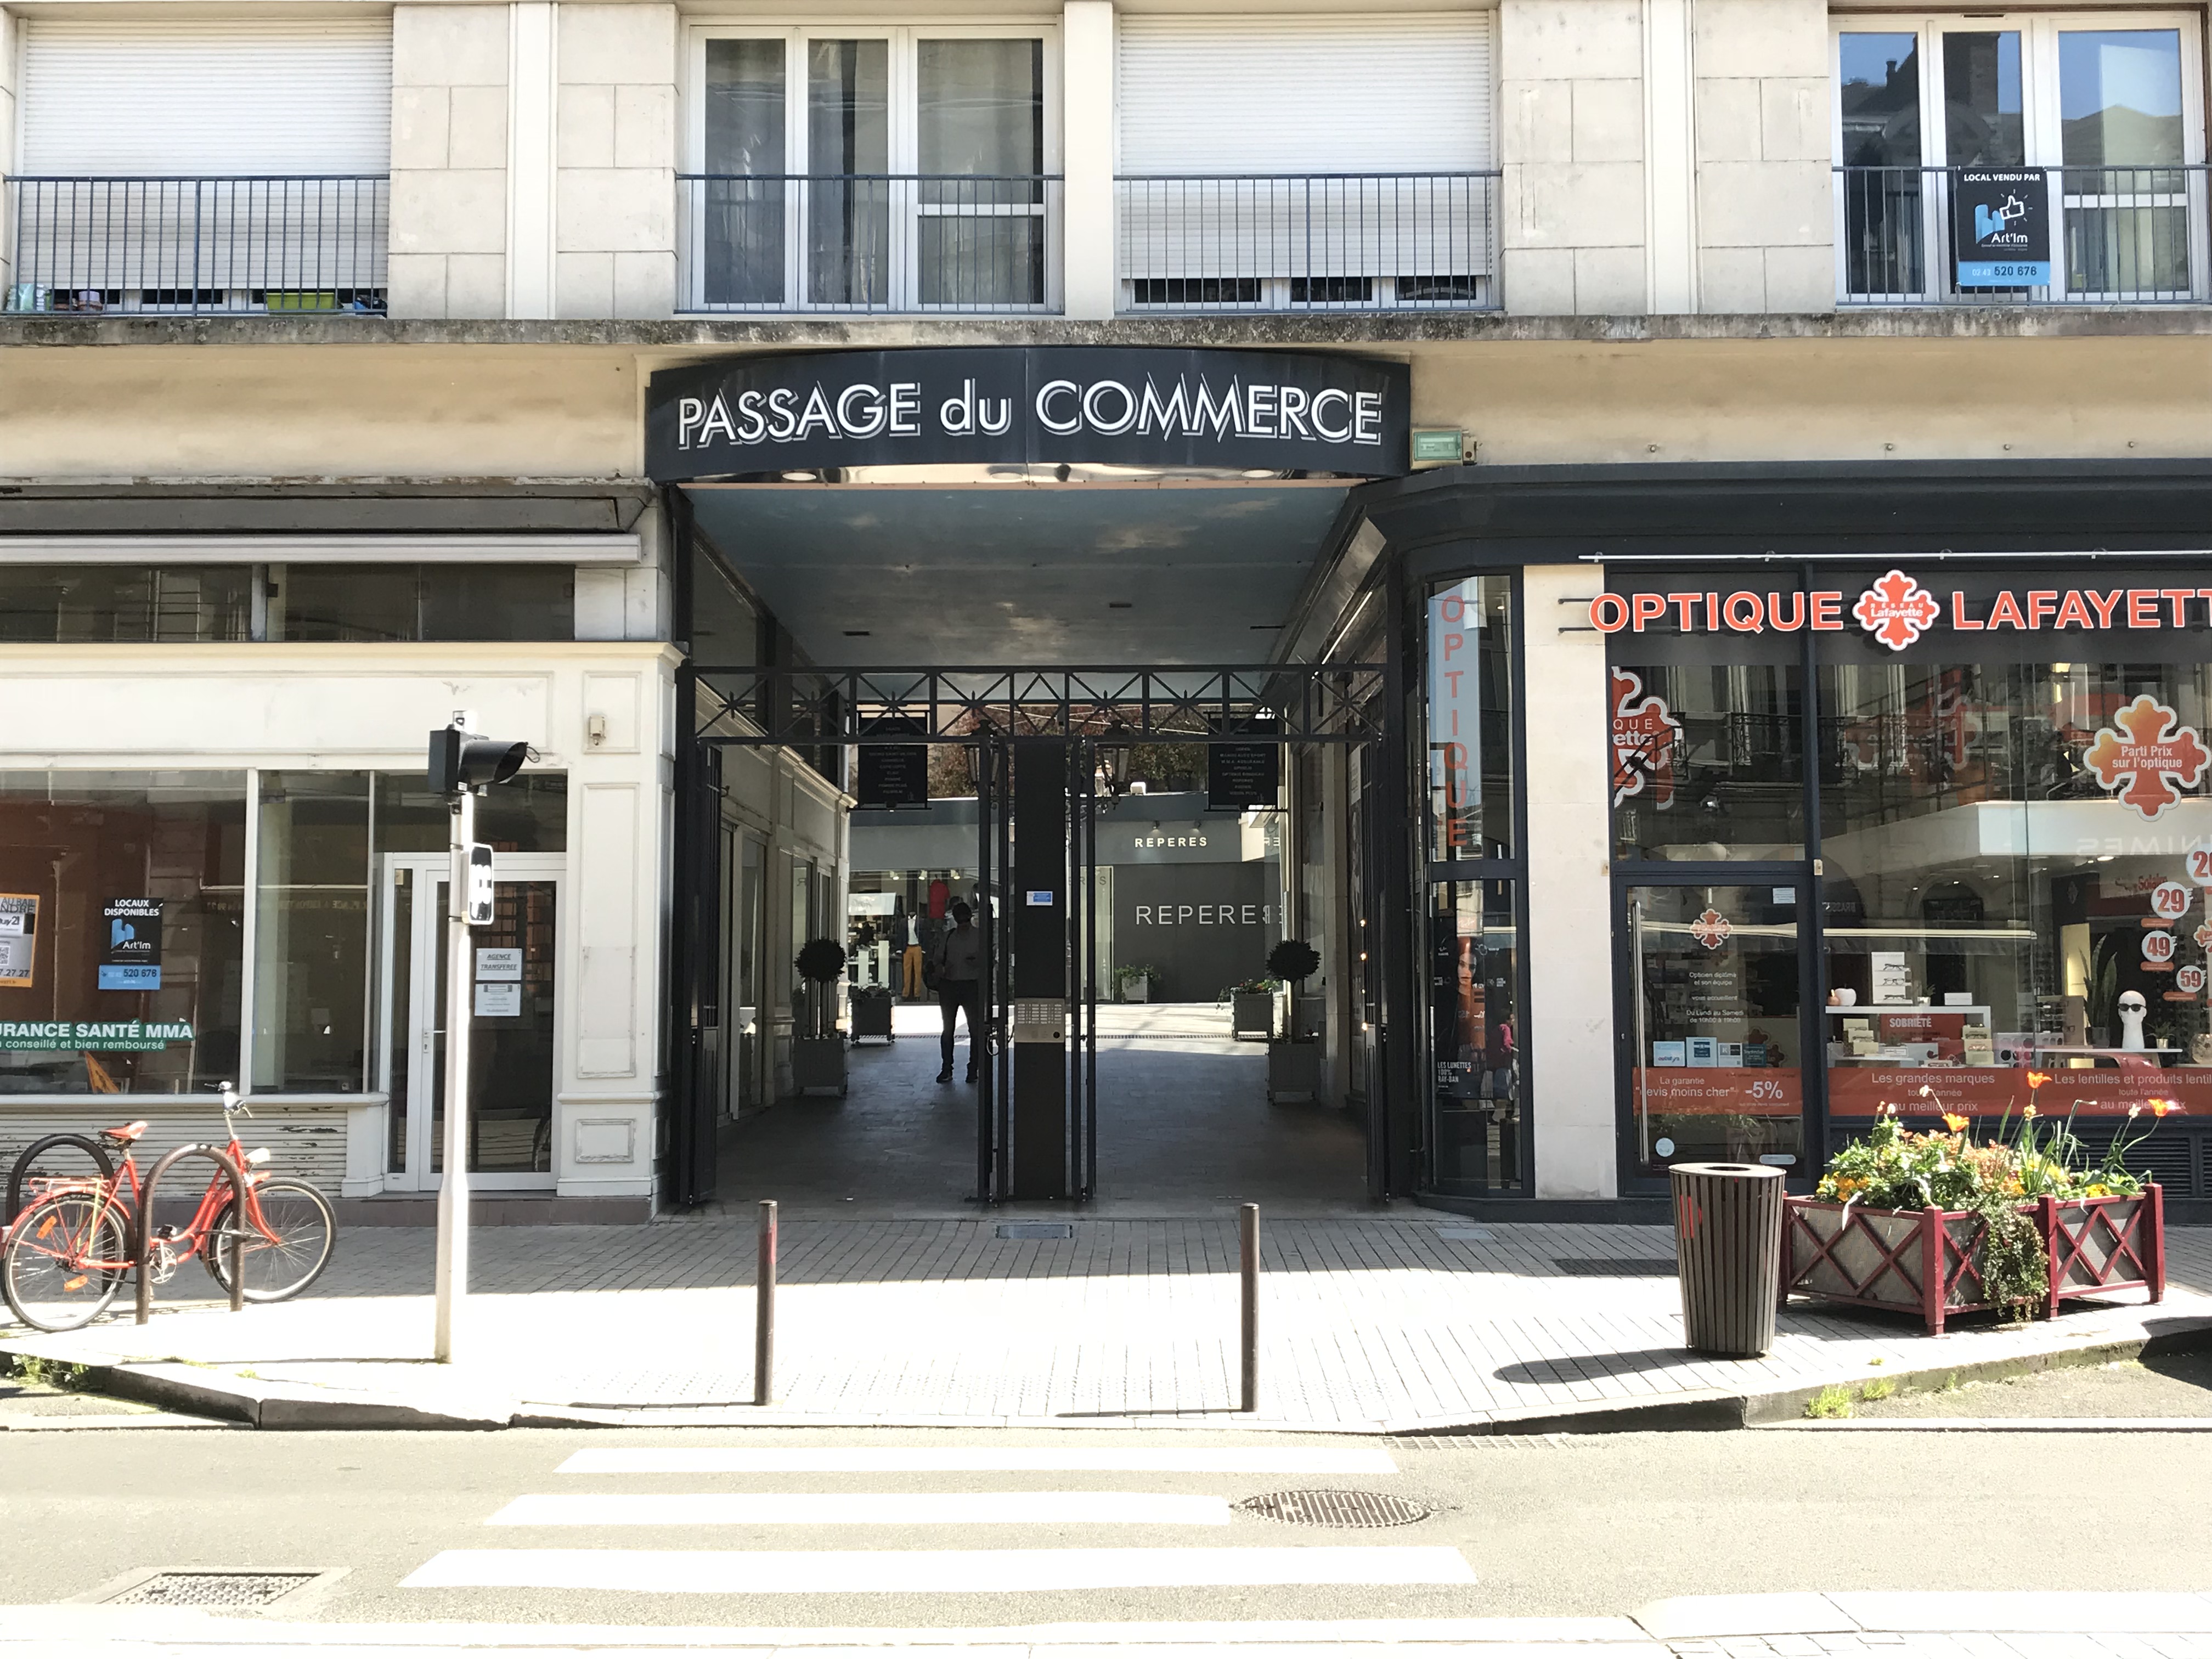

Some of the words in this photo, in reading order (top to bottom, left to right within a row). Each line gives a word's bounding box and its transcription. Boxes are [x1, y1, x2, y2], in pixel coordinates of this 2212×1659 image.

[1963, 173, 1991, 182] LOCAL
[1993, 173, 2022, 182] VENDU
[1994, 266, 2013, 276] 520
[679, 380, 921, 450] PASSAGE
[940, 377, 1012, 435] du
[1035, 372, 1382, 445] COMMERCE
[1588, 590, 1844, 634] OPTIQUE
[1871, 607, 1923, 618] Lafayette
[1441, 595, 1468, 847] OPTIQUE
[1612, 718, 1653, 730] QUE
[1612, 730, 1654, 746] ette
[2121, 746, 2147, 757] Parti
[2150, 745, 2172, 757] Prix
[2112, 758, 2130, 768] sur
[2133, 757, 2182, 770] l'optique
[1135, 837, 1207, 848] REPERES
[115, 899, 150, 907] LOCAUX
[104, 908, 160, 916] DISPONIBLES
[123, 969, 139, 978] 520
[1889, 1016, 1932, 1028] SOBRIÉTÉ
[0, 1023, 70, 1037] RANCE
[76, 1020, 140, 1037] SANTÉ
[145, 1024, 193, 1038] MMA
[5, 1040, 57, 1049] conseillé
[60, 1041, 71, 1049] et
[75, 1040, 99, 1049] bien
[103, 1040, 165, 1049] remboursé
[1660, 1076, 1670, 1085] La
[1672, 1076, 1705, 1086] garantie
[1871, 1073, 1893, 1083] Les
[1895, 1073, 1942, 1086] grandes
[1945, 1074, 1995, 1085] marques
[2055, 1074, 2075, 1084] Les
[2078, 1074, 2120, 1084] lentilles
[2124, 1075, 2135, 1084] et
[2137, 1074, 2182, 1086] produits
[1635, 1086, 1668, 1096] "evis
[1671, 1087, 1703, 1096] moins
[1745, 1080, 1784, 1099] -5%
[1909, 1102, 1955, 1111] meilleur
[1957, 1101, 1978, 1113] prix
[2100, 1101, 2114, 1109] au
